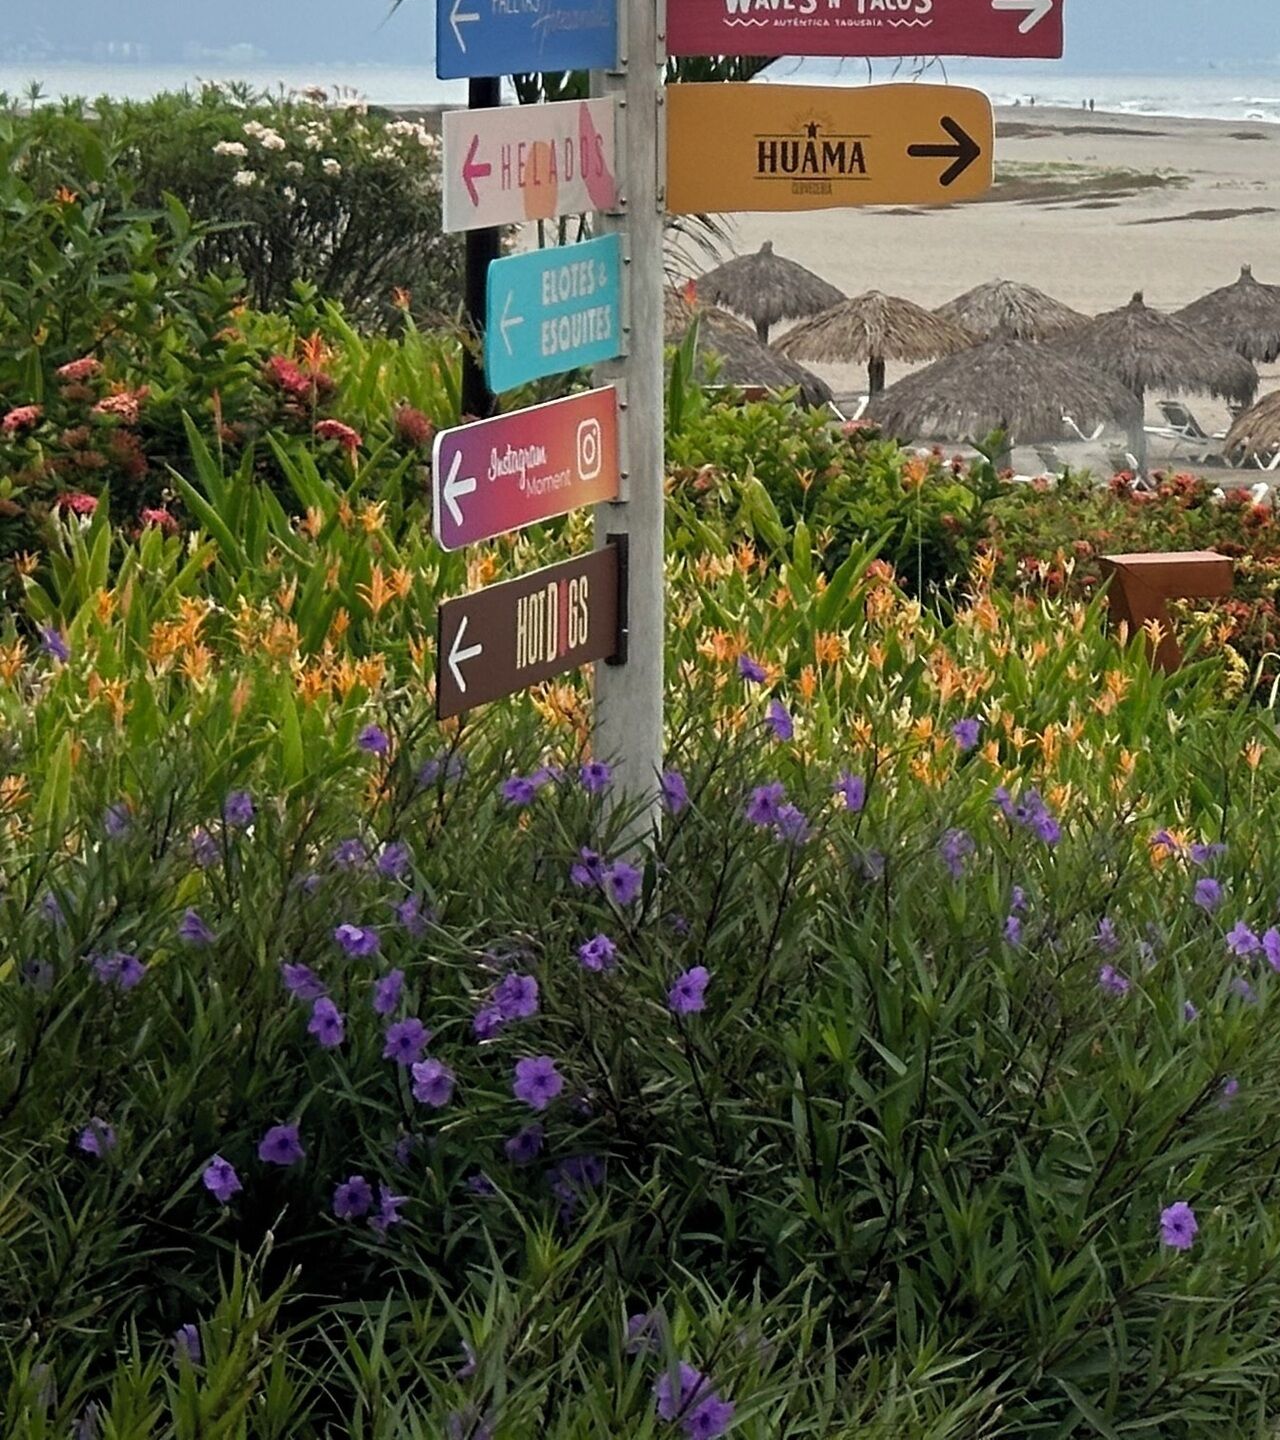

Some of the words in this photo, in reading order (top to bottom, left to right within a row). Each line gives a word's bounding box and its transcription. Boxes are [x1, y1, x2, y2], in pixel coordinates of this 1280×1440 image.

[501, 133, 604, 191] HELADOS
[542, 259, 595, 306] ELOTES
[542, 304, 611, 356] ESQUITES
[488, 444, 547, 491] Instagram
[525, 468, 571, 498] Moment
